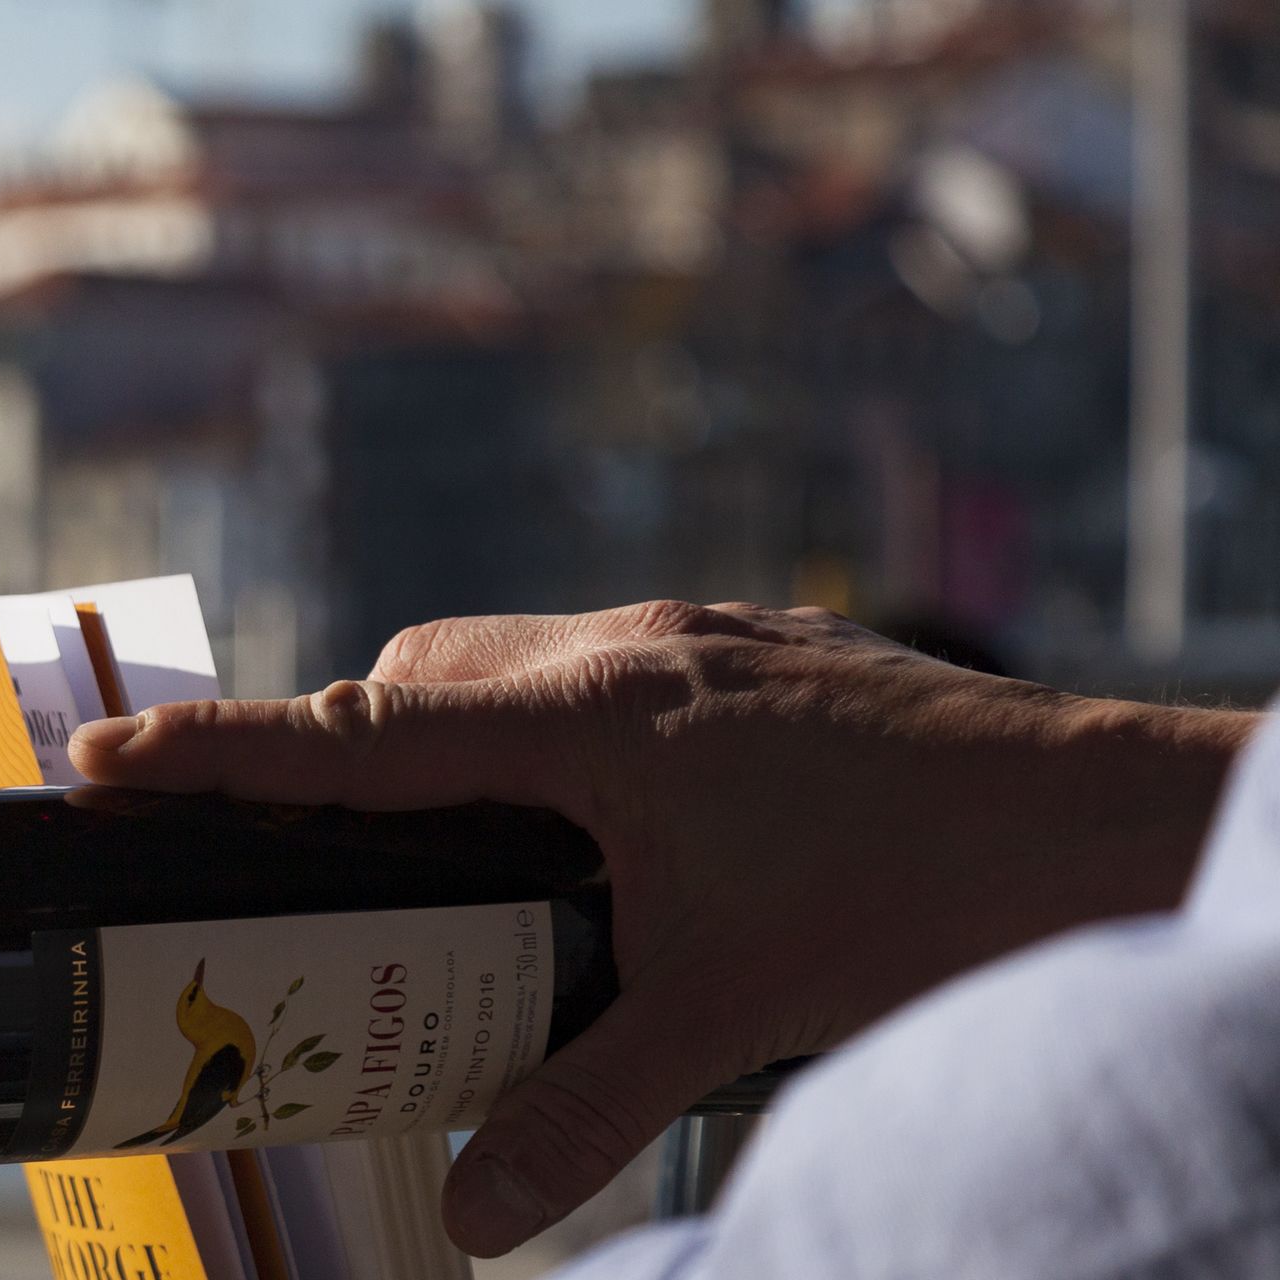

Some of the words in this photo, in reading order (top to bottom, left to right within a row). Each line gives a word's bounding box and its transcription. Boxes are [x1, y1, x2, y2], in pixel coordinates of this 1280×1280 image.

[514, 932, 537, 950] ml
[516, 954, 537, 982] 750
[41, 1116, 72, 1151] CASA
[61, 941, 89, 1110] FERREIRINHA
[330, 1081, 393, 1136] PAPA
[362, 963, 408, 1075] FIGOS
[400, 1012, 439, 1112] DOURO
[435, 1036, 449, 1078] ORIGEM
[444, 951, 455, 1031] CONTROLADA
[465, 1030, 490, 1084] TINTO
[478, 973, 495, 1021] 2016
[40, 1168, 115, 1231] THE
